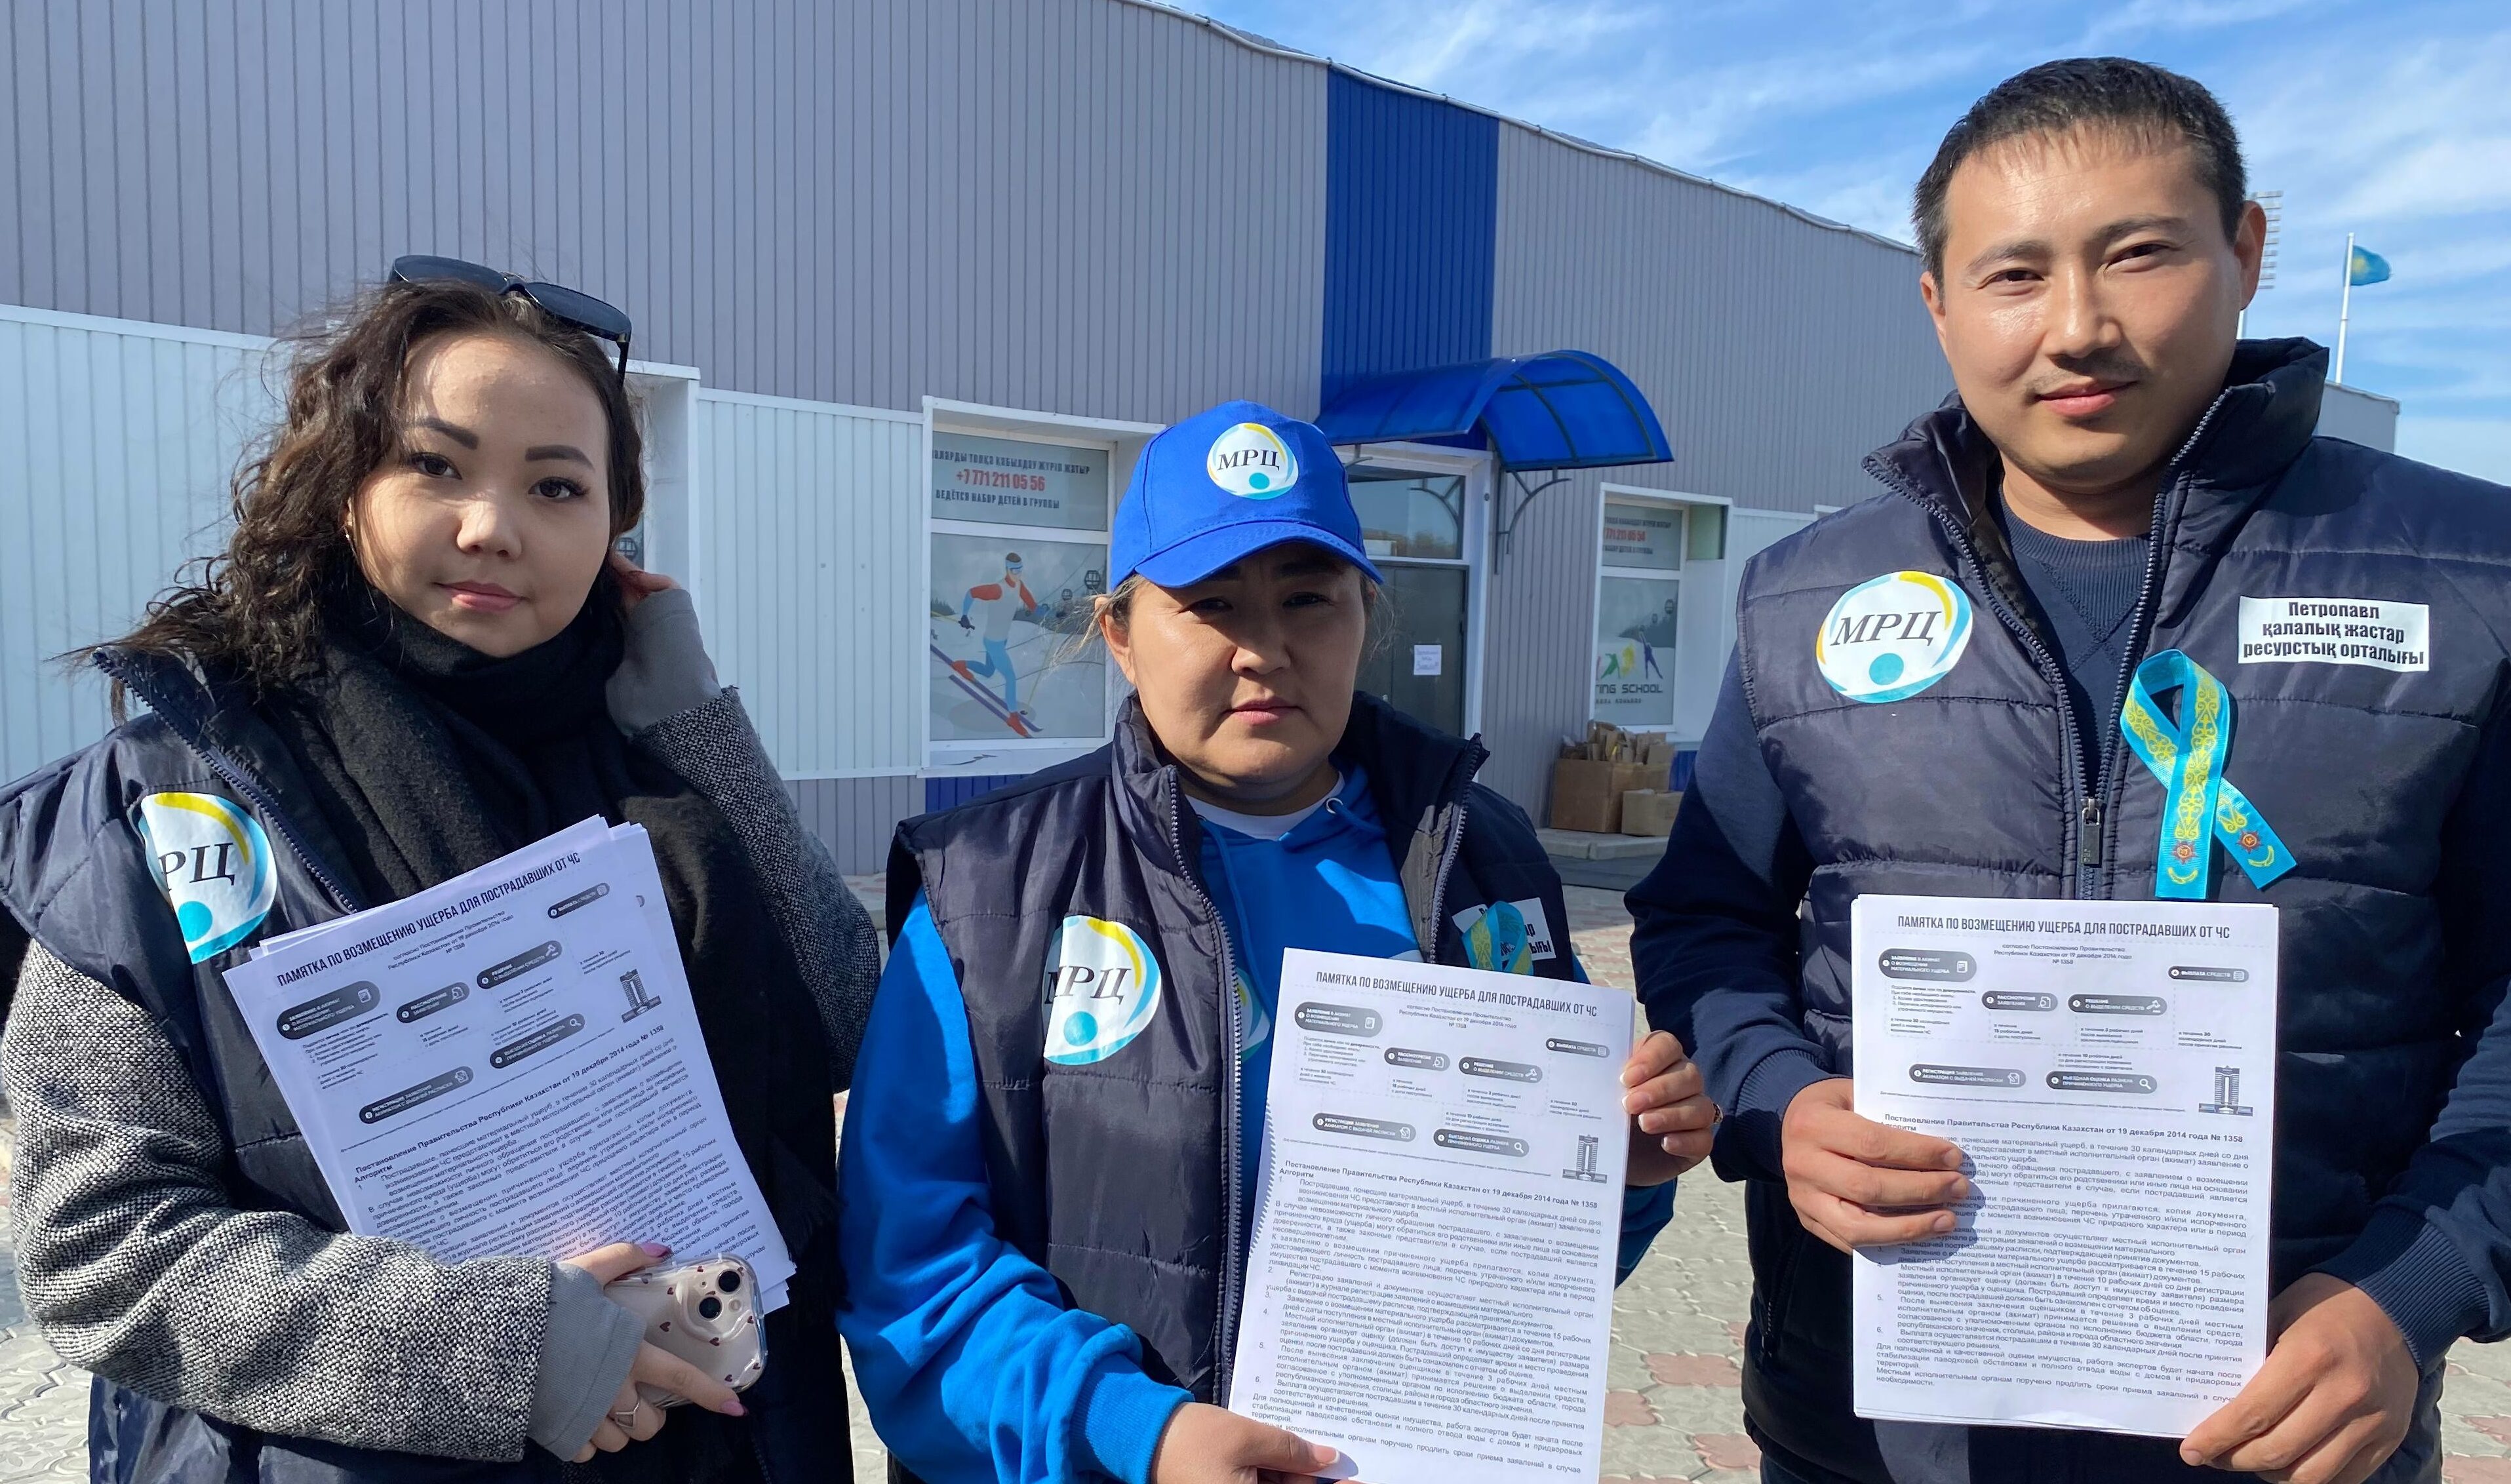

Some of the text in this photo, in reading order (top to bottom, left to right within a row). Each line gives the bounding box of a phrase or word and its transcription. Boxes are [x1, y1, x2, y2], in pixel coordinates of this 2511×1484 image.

[1064, 463, 1090, 475] ЖАТЫР
[1217, 449, 1279, 471] МРЦ
[957, 469, 1045, 491] +7 771 211 05 56
[936, 488, 1059, 509] ВЕДЁТСЯ НАБОР ДЕТЕЙ В ГРУППЫ
[2288, 602, 2379, 619] Петропавл
[1830, 611, 1942, 646] МРЦ
[2263, 623, 2404, 644] қалалық жастар
[2243, 642, 2424, 665] ресурстық орталығы
[1622, 684, 1663, 693] SCHOOL
[158, 842, 235, 892] РЦ
[277, 958, 328, 986] ПАМЯТКА
[326, 952, 344, 967] ПО
[342, 922, 417, 961] ВОЗМЕЩЕНИЮ
[415, 905, 459, 931] УЩЕРБА
[459, 895, 481, 915] ДЛЯ
[480, 863, 556, 905] ПОСТРАДАВШИХ
[555, 857, 567, 871] ОТ
[566, 852, 581, 865] ЧС
[1898, 916, 2230, 939] ПАМЯТКА ПО ВОЗМЕЩЕНИЮ УЩЕРБА ДЛЯ ПОСТРАДАВШИХ ОТ ЧС
[1316, 971, 1597, 1017] ПАМЯТКА ПО ВОЗМЕЩЕНИЮ УЩЕРБА ДЛЯ ПОСТРАДАВШИХ ОТ ЧС
[355, 1146, 417, 1174] Постановление
[417, 1120, 478, 1149] Правительства
[477, 1099, 524, 1123] Республики
[524, 1081, 562, 1103] Казахстан
[562, 1076, 570, 1084] от
[581, 1055, 609, 1076] декабря
[608, 1046, 625, 1059] 2014
[625, 1039, 641, 1050] года
[1885, 1114, 1945, 1125] Постановление
[1947, 1119, 2009, 1128] Правительства
[2011, 1122, 2060, 1131] Республики
[2062, 1124, 2104, 1133] Казахстан
[2129, 1129, 2165, 1138] декабря
[2223, 1135, 2244, 1143] 1358
[355, 1164, 393, 1184] Алгоритм
[1278, 1167, 1314, 1179] Алгоритм
[1285, 1160, 1341, 1173] Постановление
[1342, 1167, 1397, 1182] Правительства
[1398, 1175, 1442, 1188] Республики
[1444, 1181, 1480, 1193] Казахстан
[1501, 1191, 1533, 1200] декабря
[1533, 1194, 1551, 1203] 2014
[1581, 1200, 1598, 1209] 1358
[1897, 1337, 1966, 1348] соответствующего
[1900, 1328, 1933, 1337] Выплата
[1933, 1332, 1994, 1341] осуществляется
[1995, 1336, 2052, 1344] пострадавшим
[2058, 1339, 2091, 1348] течение
[2103, 1344, 2156, 1354] календарных
[2156, 1349, 2177, 1358] дней
[2204, 1354, 2242, 1363] принятия
[1876, 1359, 1920, 1369] территорий.
[1894, 1345, 1943, 1354] полноценной
[1954, 1350, 2006, 1359] качественной
[2038, 1355, 2083, 1365] имущества,
[2086, 1357, 2114, 1367] работа
[2116, 1361, 2157, 1371] экспертов
[2160, 1365, 2183, 1375] будет
[2186, 1369, 2214, 1378] начата
[1876, 1376, 1935, 1386] необходимости.
[1876, 1367, 1911, 1377] Местным
[1914, 1371, 1977, 1380] исполнительным
[2055, 1380, 2092, 1388] продлить
[2122, 1386, 2154, 1396] приема
[2156, 1390, 2199, 1399] заявлений
[2212, 1396, 2234, 1405] случ
